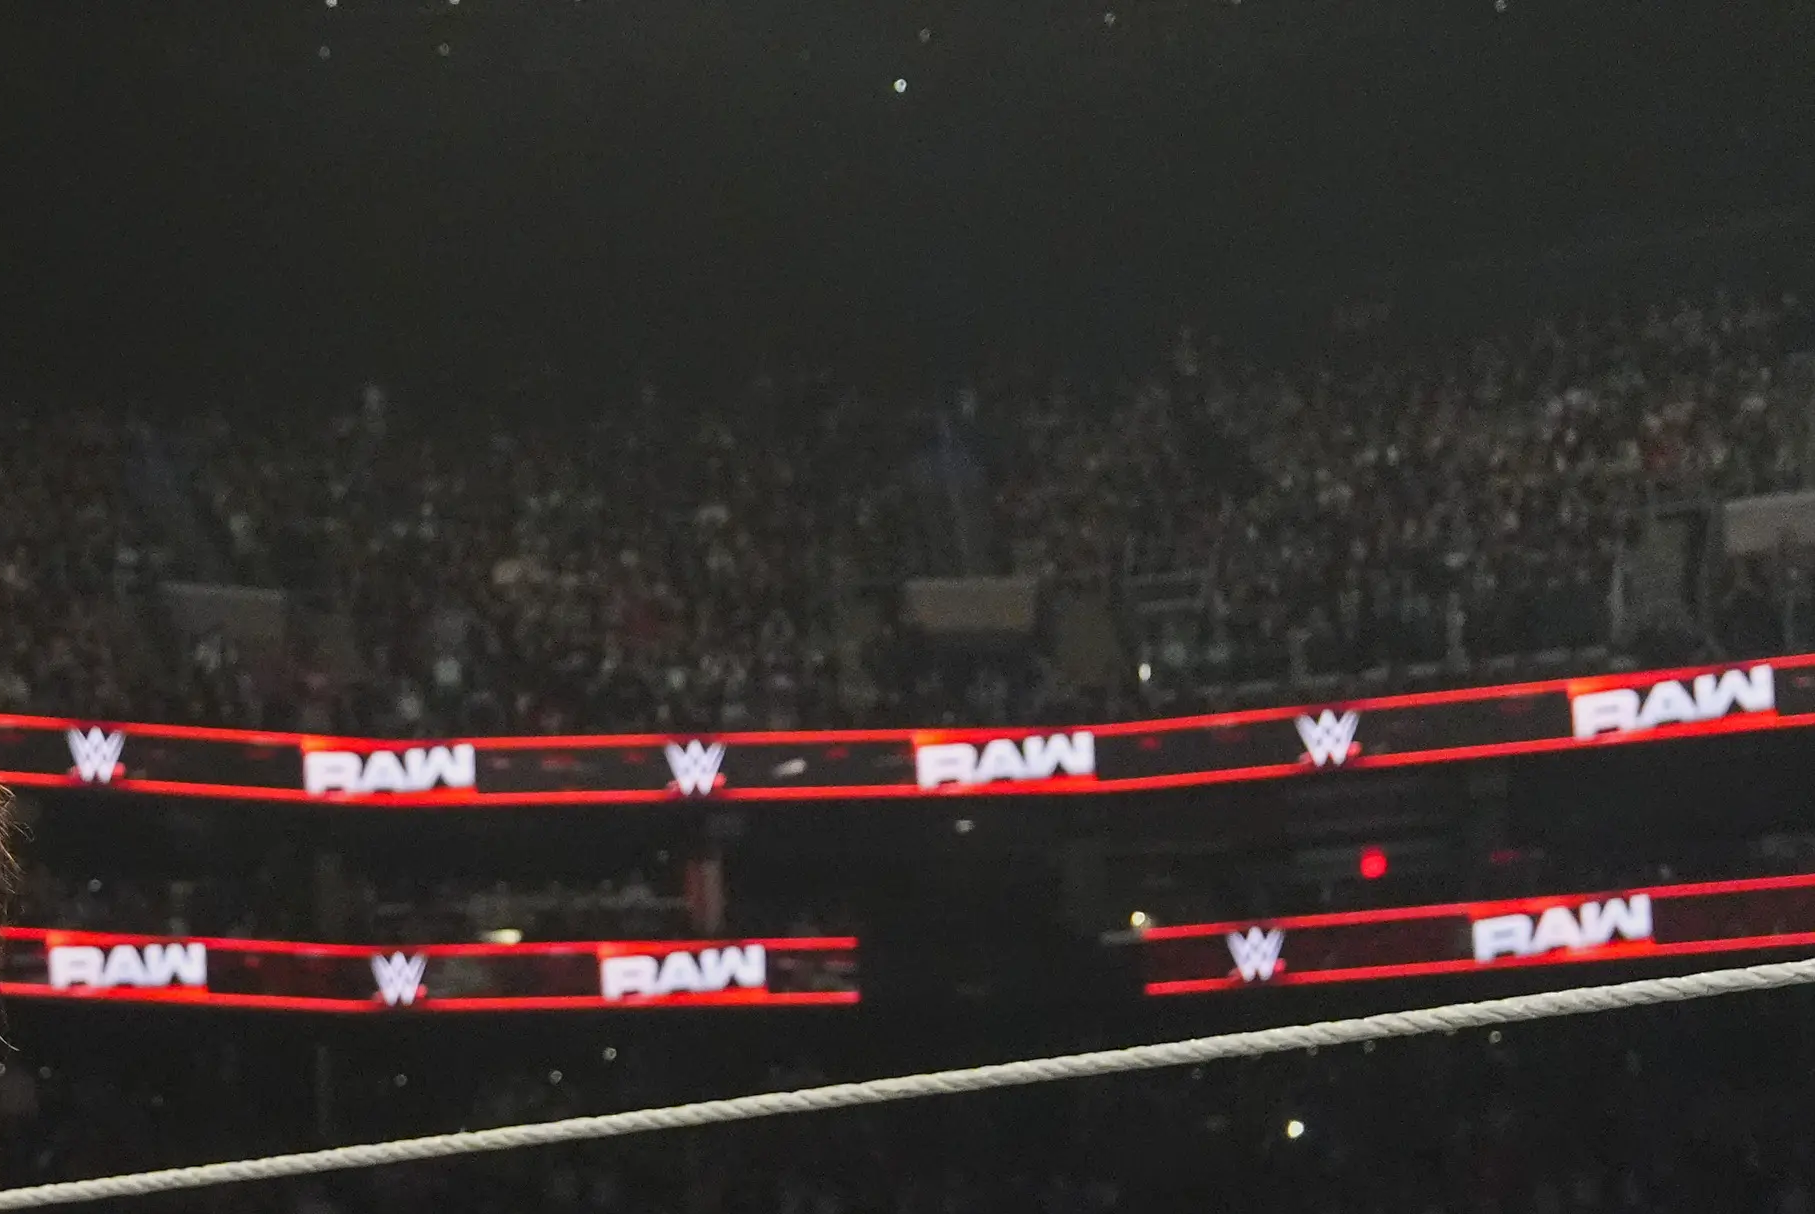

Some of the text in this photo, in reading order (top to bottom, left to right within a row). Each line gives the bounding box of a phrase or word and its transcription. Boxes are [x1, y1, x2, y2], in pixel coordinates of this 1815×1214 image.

[1573, 664, 1775, 741] RAW
[303, 744, 475, 797] RAW
[915, 731, 1095, 790] RAW
[1472, 894, 1653, 964] RAW
[48, 943, 207, 990] RAW
[601, 944, 766, 1001] RAW
